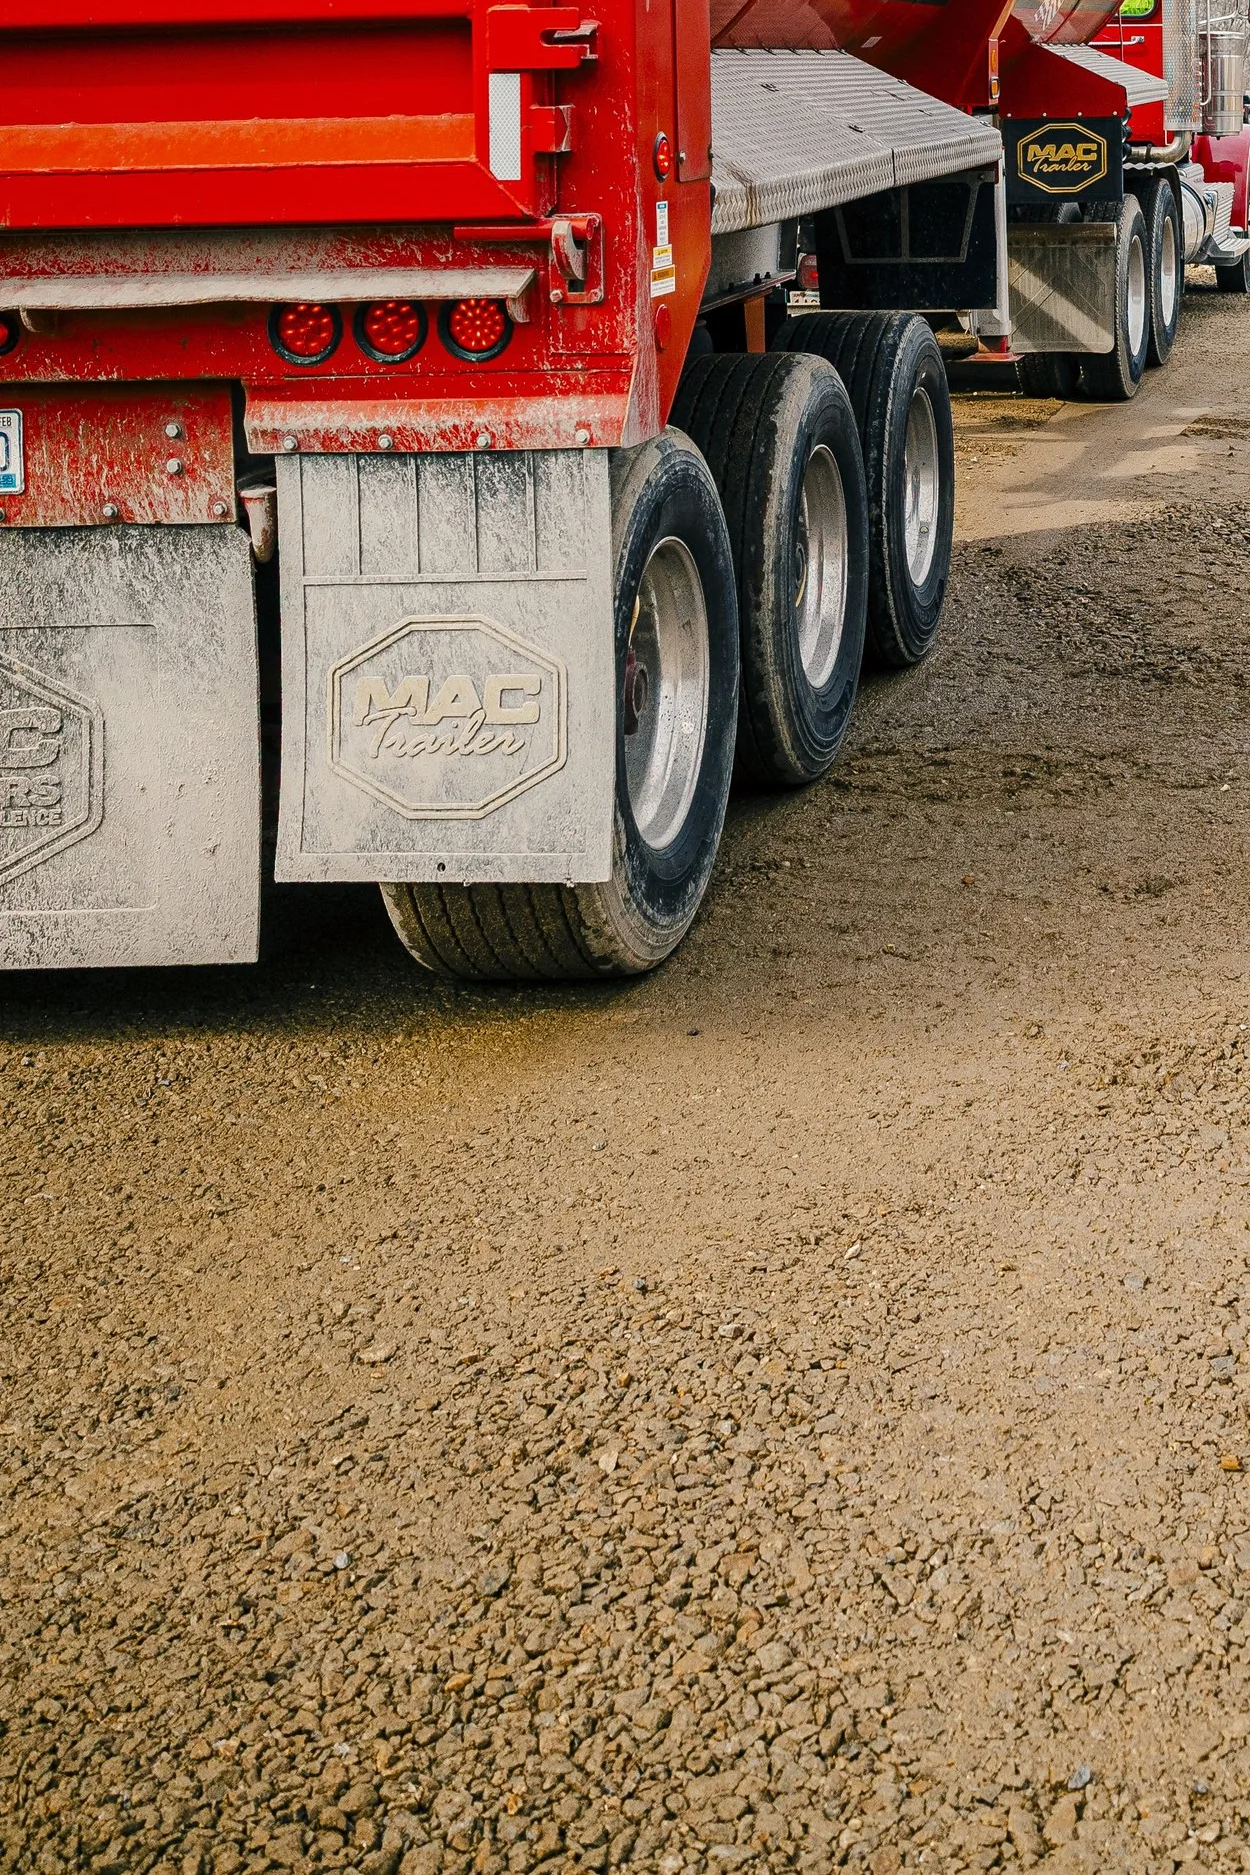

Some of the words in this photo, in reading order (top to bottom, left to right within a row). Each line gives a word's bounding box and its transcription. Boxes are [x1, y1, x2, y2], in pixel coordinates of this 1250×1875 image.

[1027, 143, 1098, 162] MAC
[1031, 154, 1092, 173] Trailer
[353, 673, 542, 727] MAC
[362, 707, 526, 758] Trailer
